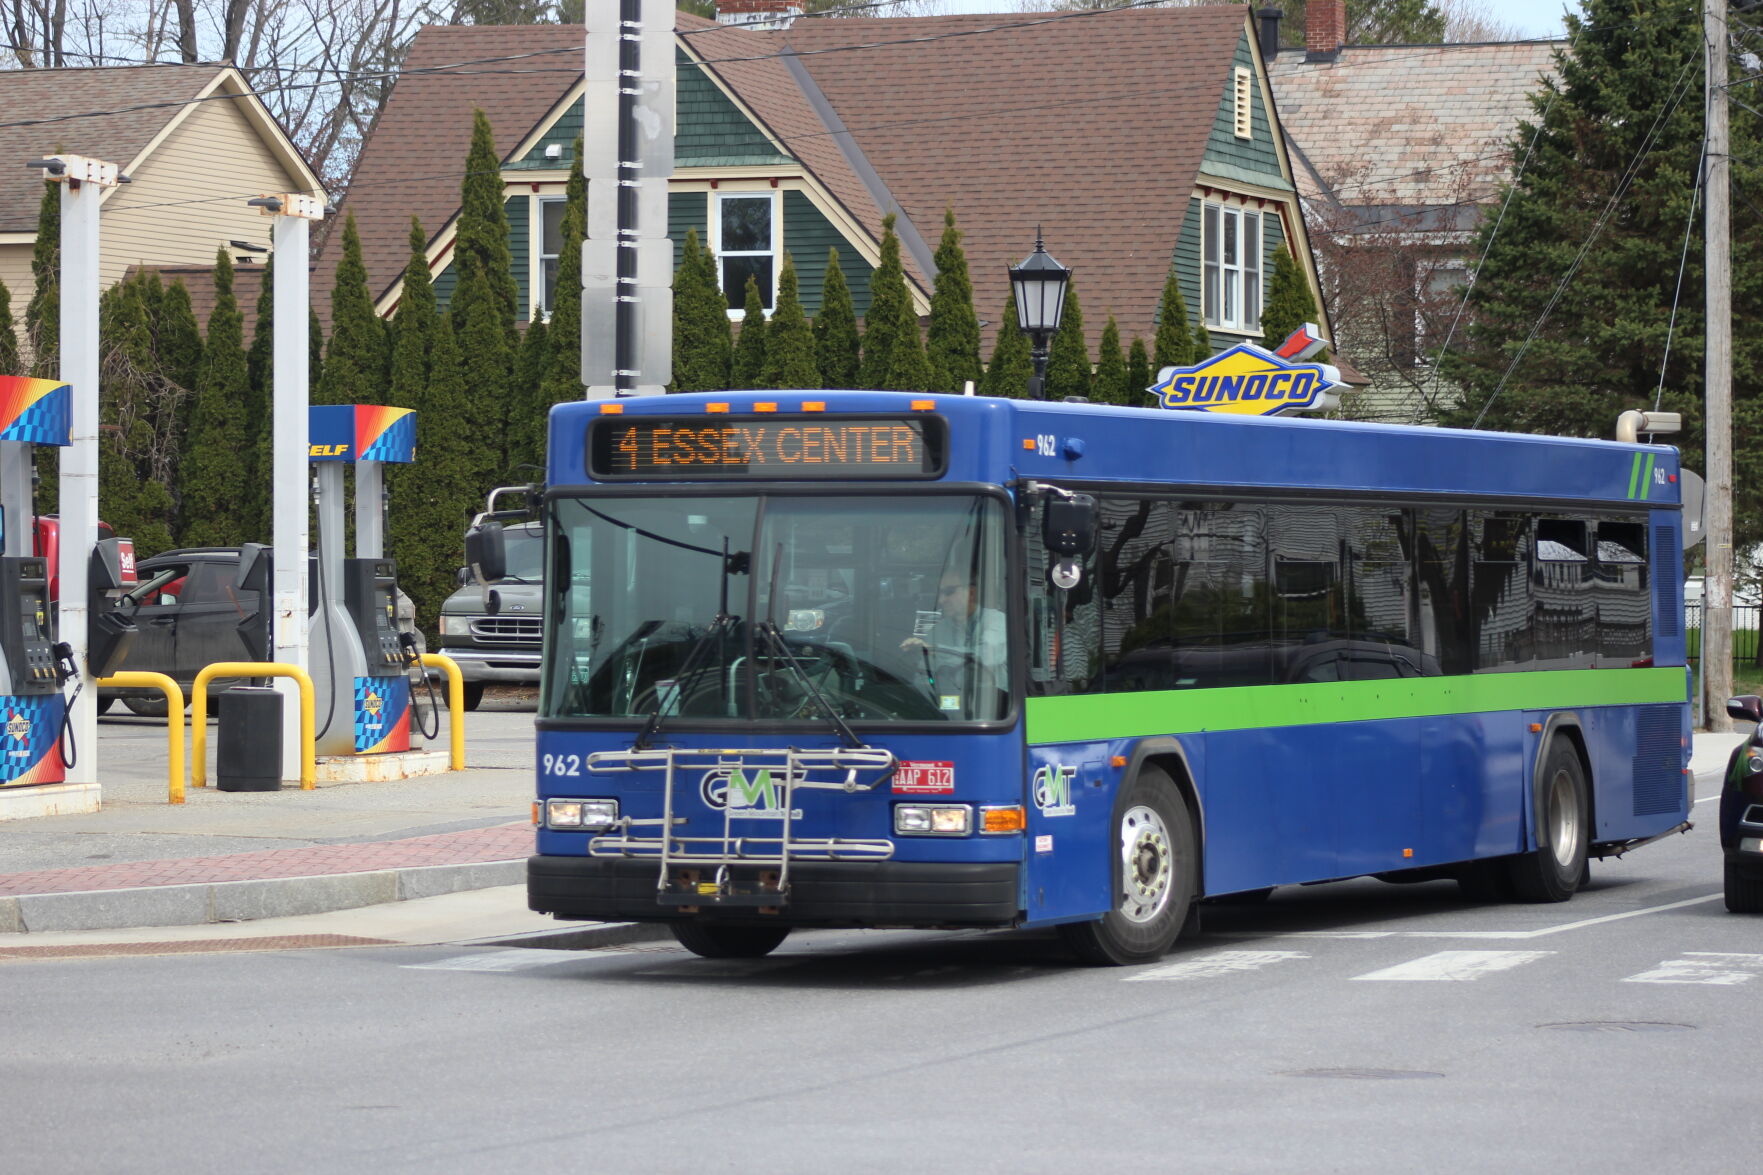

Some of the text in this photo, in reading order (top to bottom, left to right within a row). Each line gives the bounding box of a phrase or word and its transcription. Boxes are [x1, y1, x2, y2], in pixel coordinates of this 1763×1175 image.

[1168, 373, 1316, 403] SUNOCO
[619, 426, 915, 470] 4 ESSEX CENTER
[1037, 434, 1056, 457] 962
[1653, 467, 1666, 485] 962
[543, 753, 580, 776] 962
[900, 769, 920, 785] AAP
[927, 769, 949, 786] 612
[700, 768, 808, 811] GMT
[1033, 763, 1077, 810] GMT
